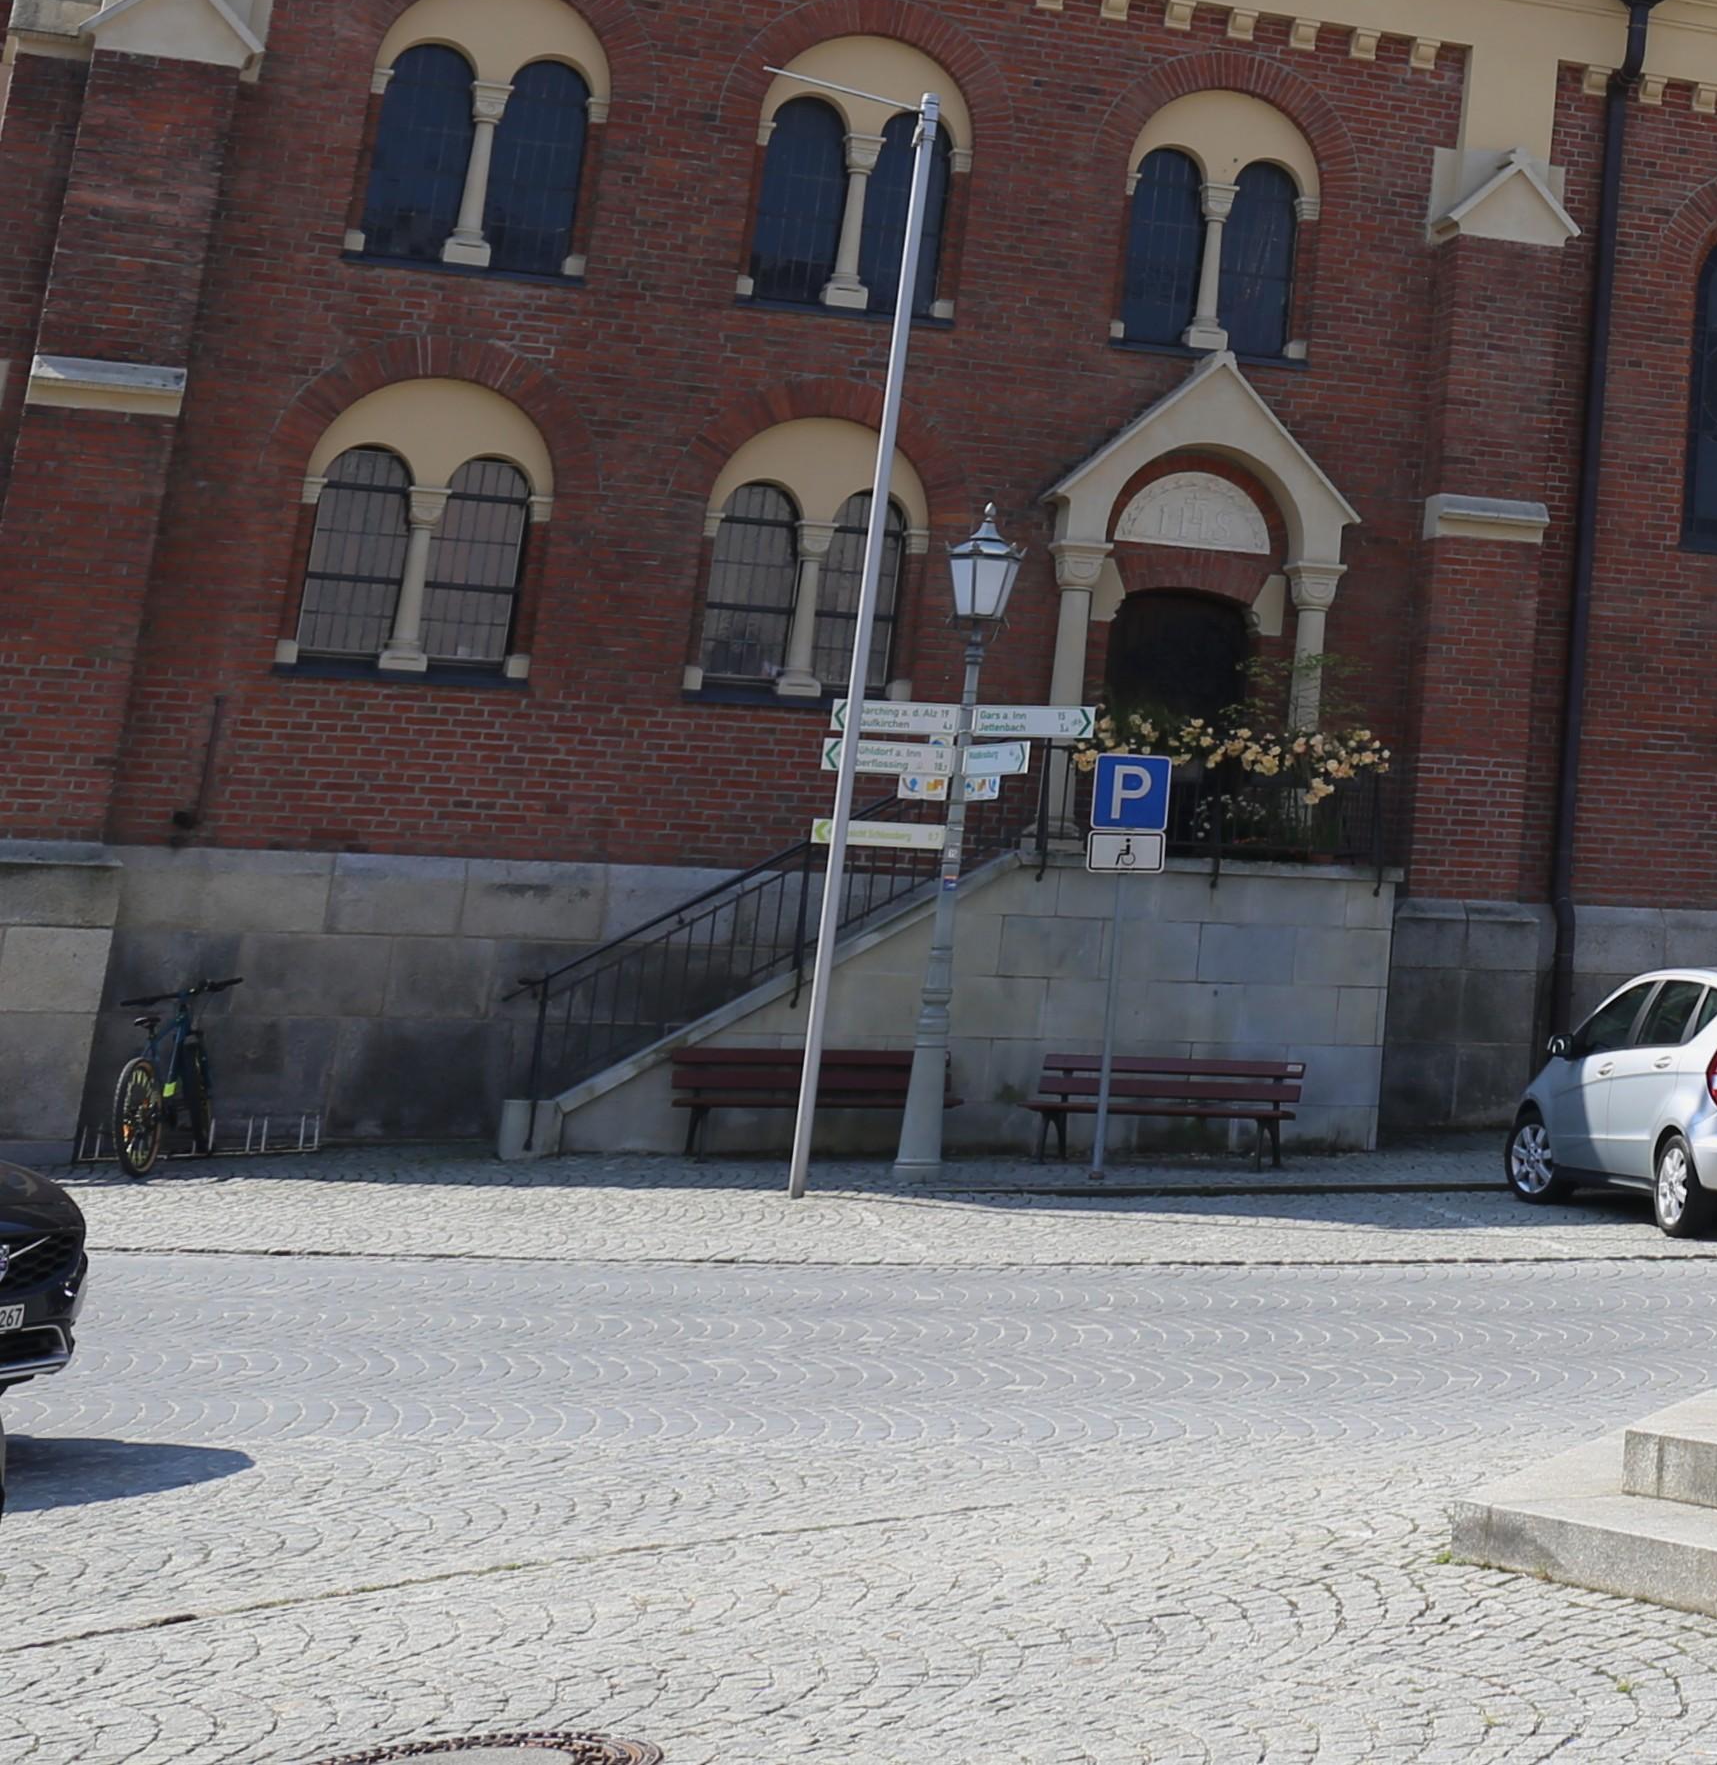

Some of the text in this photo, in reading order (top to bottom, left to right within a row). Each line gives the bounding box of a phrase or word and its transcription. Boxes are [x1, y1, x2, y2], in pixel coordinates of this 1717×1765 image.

[979, 710, 1001, 720] Gars
[978, 723, 1026, 732] Jettenbach
[859, 745, 894, 757] ühldorf
[857, 759, 909, 772] berflossing
[1110, 765, 1152, 821] P
